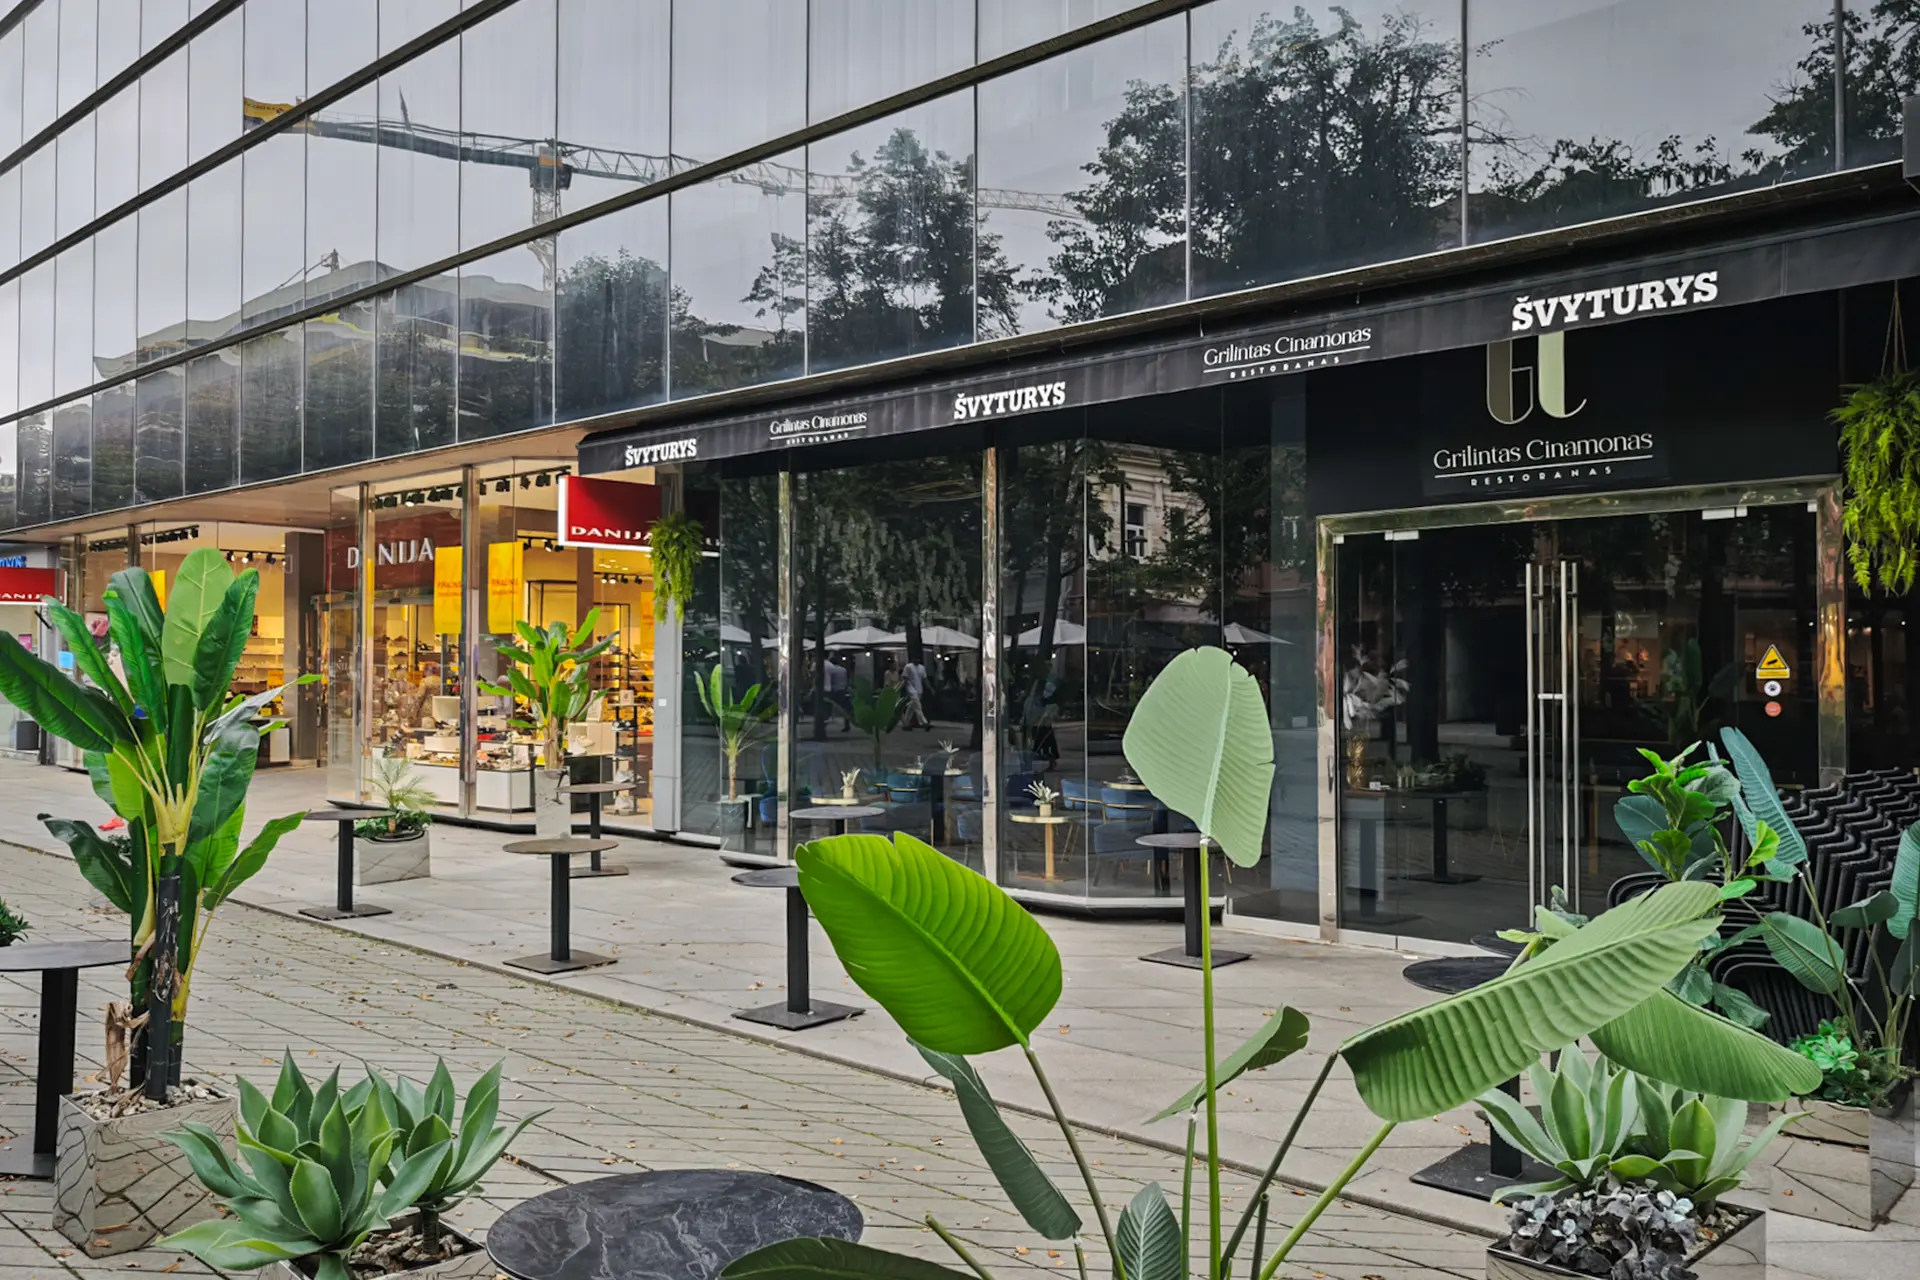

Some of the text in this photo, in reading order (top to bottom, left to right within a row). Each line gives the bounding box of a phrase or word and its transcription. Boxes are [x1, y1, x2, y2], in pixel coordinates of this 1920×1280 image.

[1510, 271, 1719, 333] ŠVYTURYS
[1203, 327, 1372, 366] Grilintas Cinamonas
[953, 381, 1066, 420] ŠVYTURYS
[624, 438, 697, 467] ŠVYTURYS
[1433, 432, 1654, 470] Grilintas Cinamonas
[1470, 465, 1612, 487] RESTORANAS
[347, 537, 434, 569] DNIJA
[0, 592, 41, 600] ANIJ
